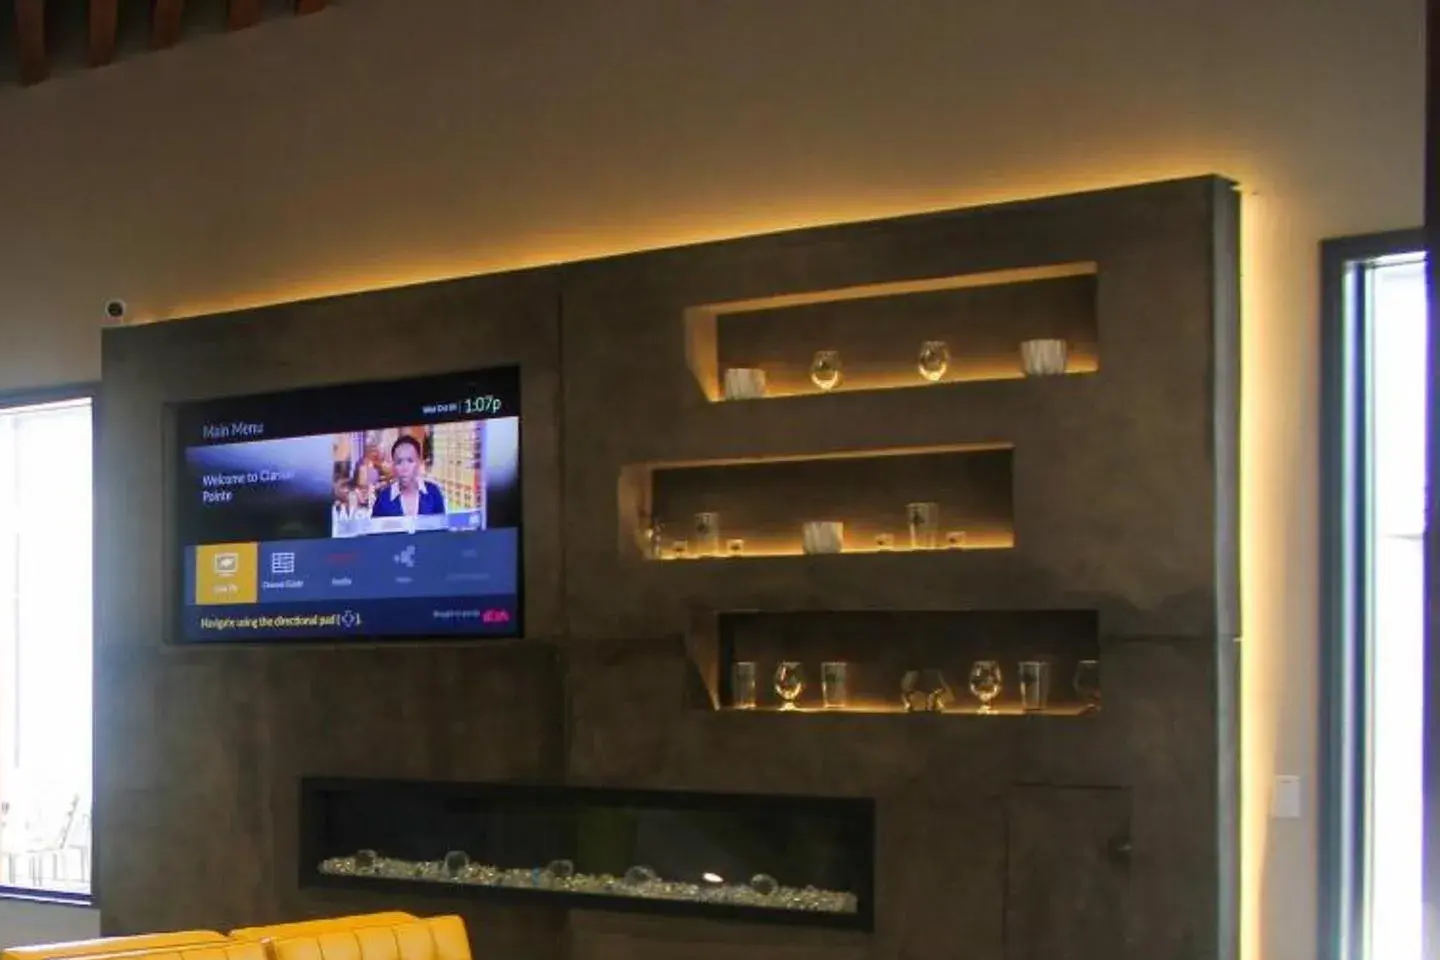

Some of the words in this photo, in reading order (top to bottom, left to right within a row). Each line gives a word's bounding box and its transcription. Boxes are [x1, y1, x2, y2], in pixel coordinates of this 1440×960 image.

[465, 395, 502, 414] 1:07p
[202, 424, 229, 438] Main
[231, 421, 264, 436] Menu
[203, 473, 246, 487] Welcome
[247, 473, 258, 483] to
[259, 616, 273, 627] the
